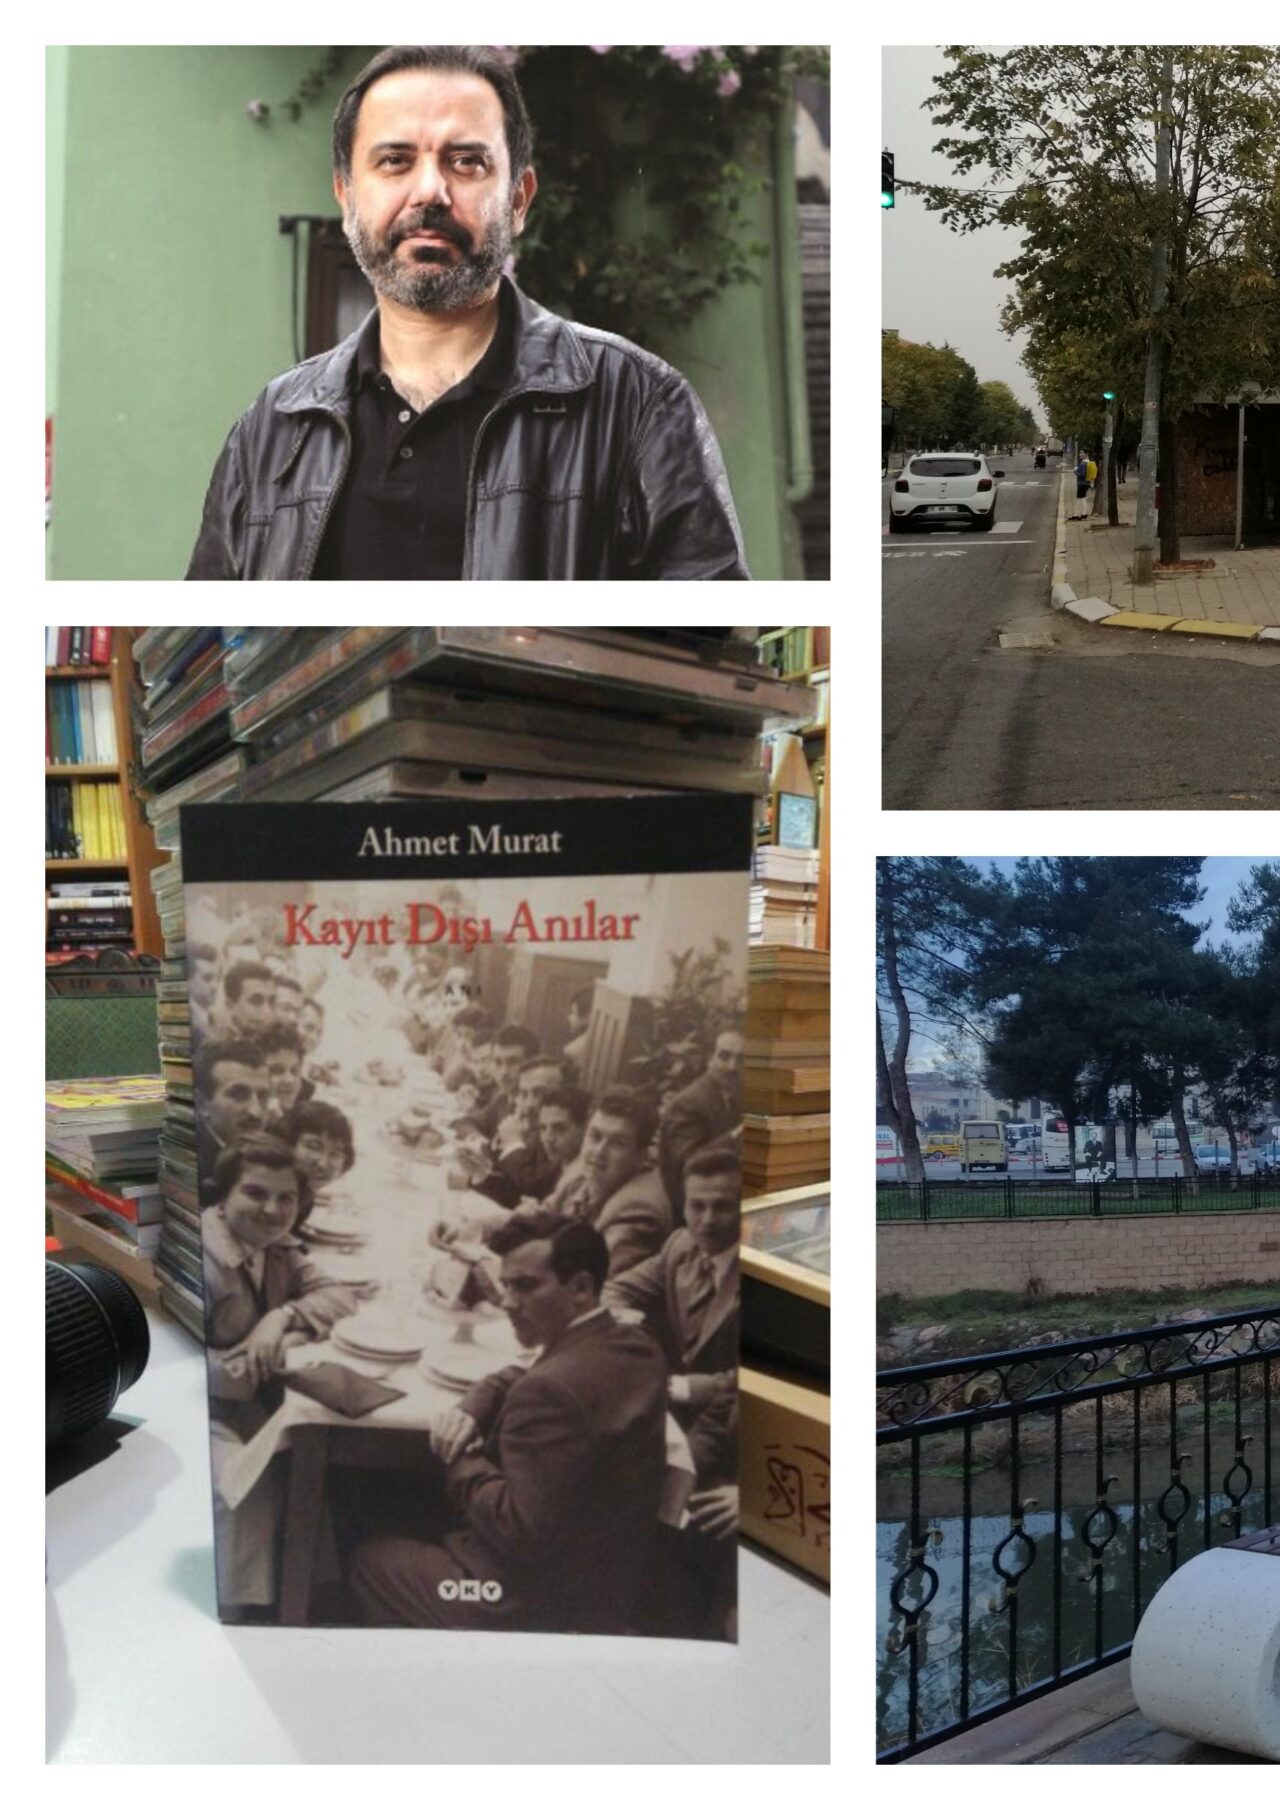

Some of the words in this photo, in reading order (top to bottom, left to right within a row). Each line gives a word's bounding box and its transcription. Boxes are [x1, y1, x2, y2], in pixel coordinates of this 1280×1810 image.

[357, 826, 460, 857] Ahmet
[467, 824, 563, 855] Murat
[282, 902, 396, 960] Kayıt
[405, 901, 494, 953] Dışı
[503, 898, 640, 943] Anılar
[440, 1581, 500, 1599] YKY
